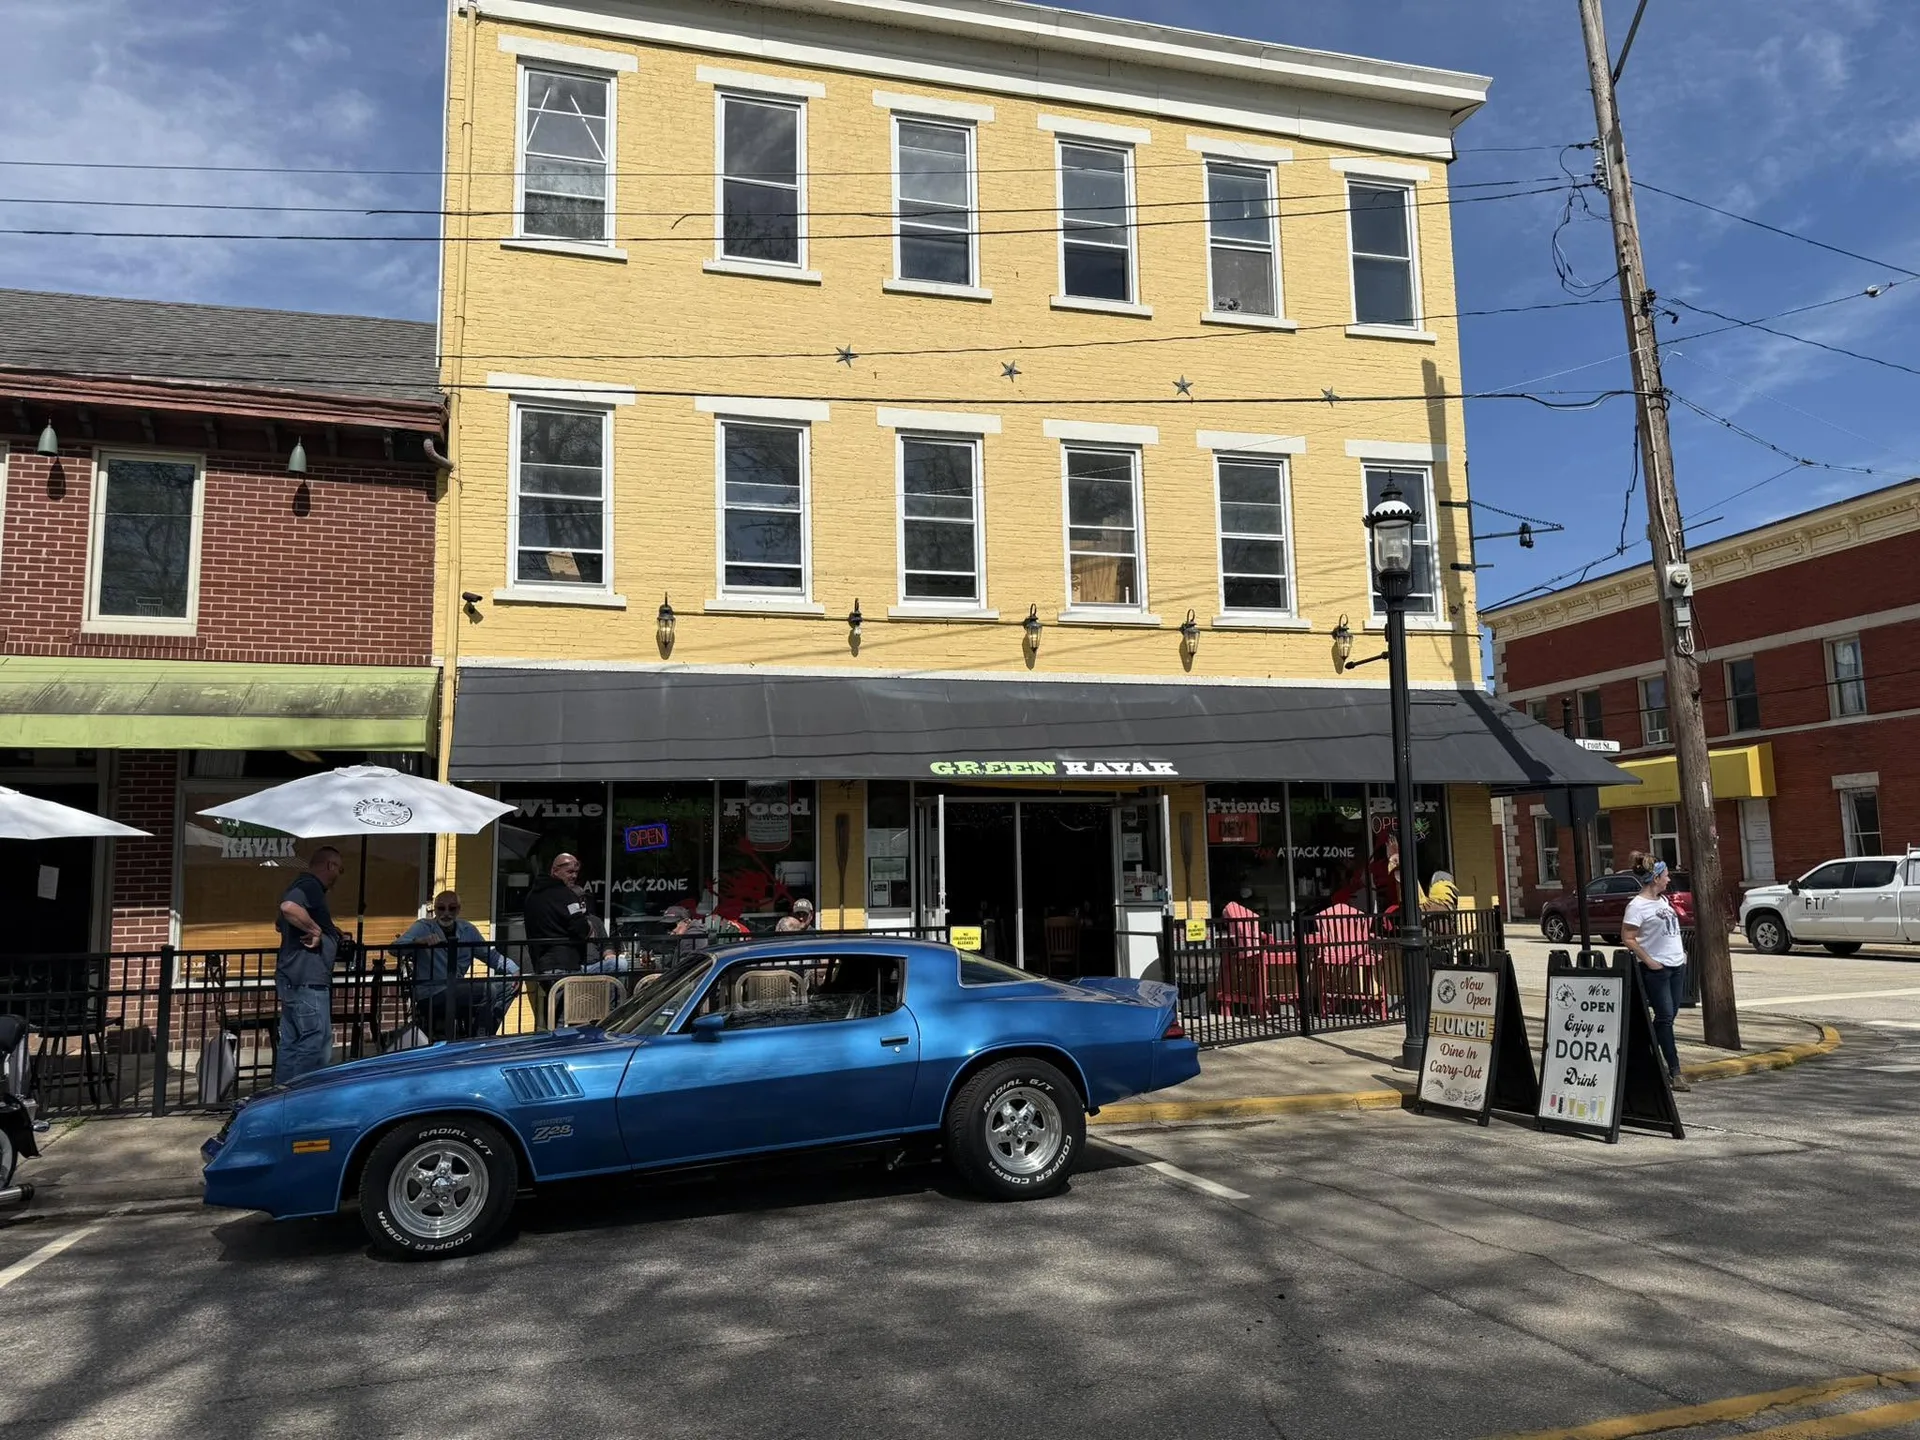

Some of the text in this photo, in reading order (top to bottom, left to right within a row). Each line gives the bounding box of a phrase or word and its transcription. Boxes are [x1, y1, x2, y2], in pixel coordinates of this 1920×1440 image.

[930, 761, 1179, 775] GREEN KAYAK
[353, 798, 406, 817] WHITE CLAW
[504, 798, 604, 818] Wine
[722, 798, 811, 816] Food
[1207, 797, 1281, 814] Friends
[1371, 816, 1400, 834] OPE
[628, 827, 666, 847] OPEN
[220, 837, 297, 858] KAYAK
[1277, 846, 1320, 859] ATACK
[1321, 846, 1356, 858] ZONE
[646, 878, 689, 892] ZONE
[1460, 976, 1484, 990] Now
[1588, 983, 1611, 996] We're
[1466, 991, 1492, 1010] Open
[1580, 1001, 1616, 1013] OPEN
[1433, 1015, 1488, 1039] LUNCH
[1564, 1013, 1606, 1038] Enjoy a
[1440, 1042, 1478, 1060] Dine In
[1555, 1039, 1613, 1063] DORA
[1429, 1060, 1483, 1080] Carry-Out
[1563, 1066, 1598, 1088] Drink
[983, 1078, 1055, 1113] RADIAL G/T
[418, 1128, 494, 1156] RADIAL G/T
[531, 1124, 574, 1145] Z28
[988, 1134, 1073, 1185] COOPER COBRA
[377, 1210, 473, 1252] COOPER COBRA
